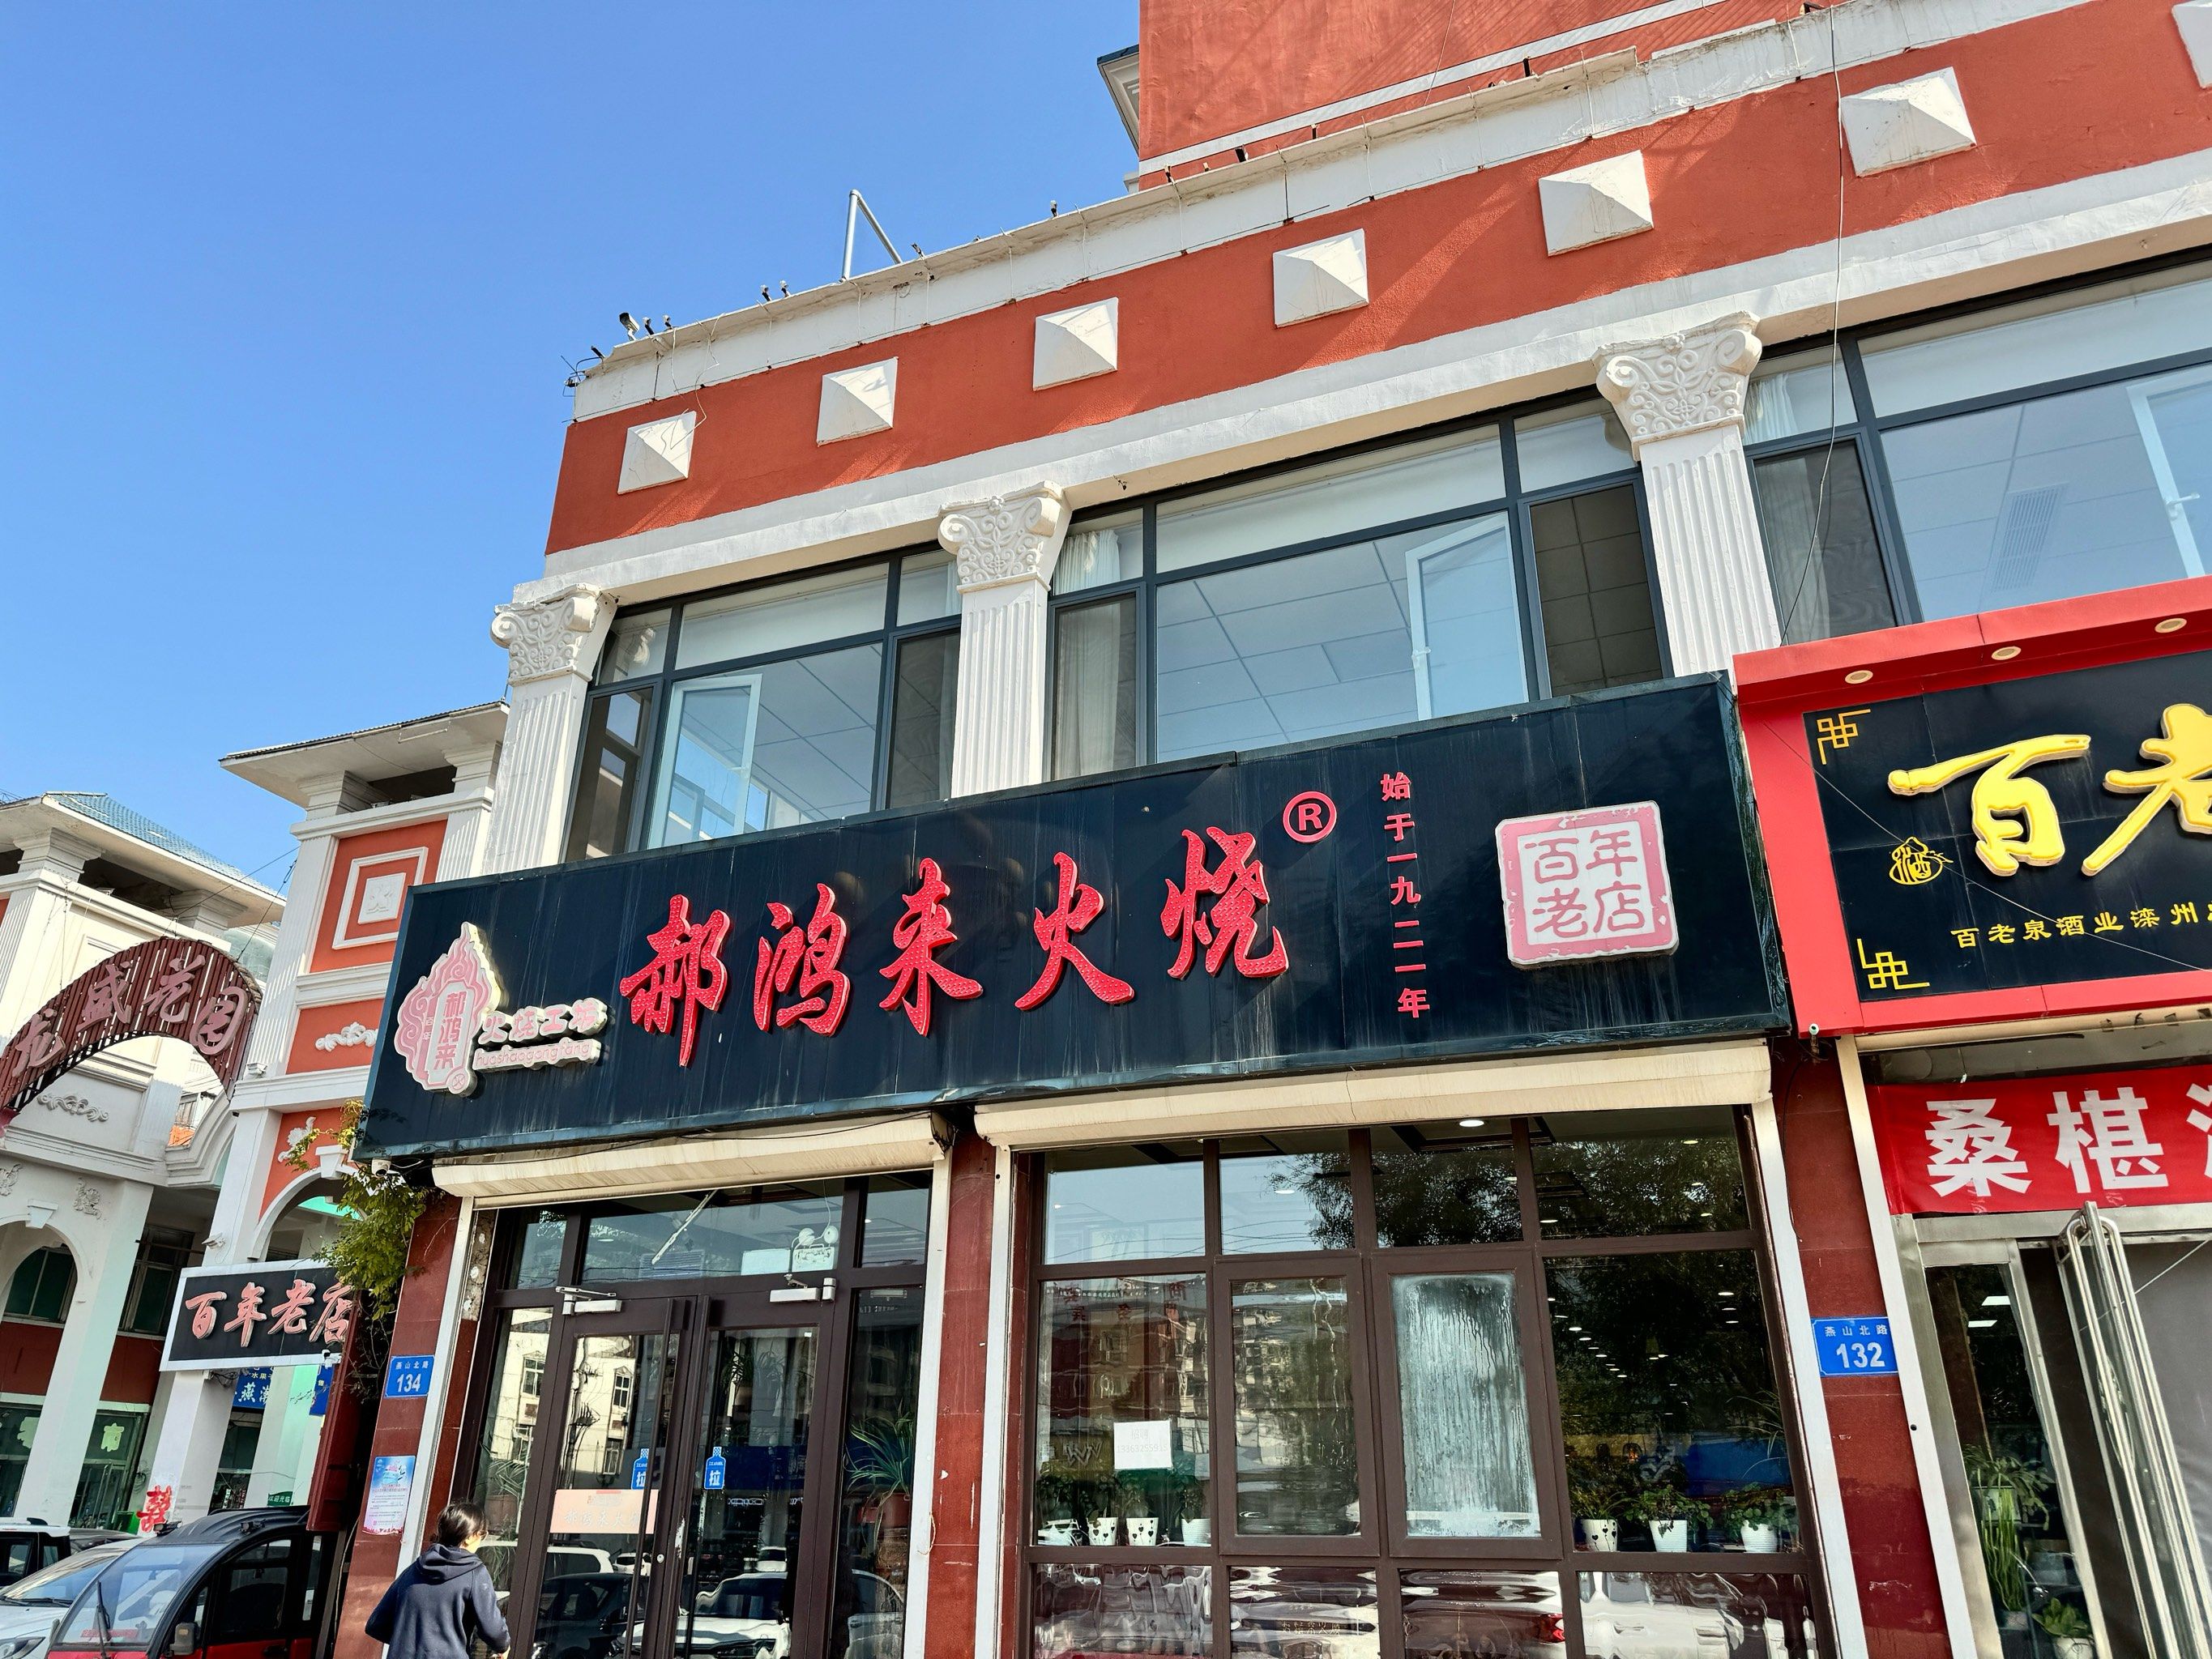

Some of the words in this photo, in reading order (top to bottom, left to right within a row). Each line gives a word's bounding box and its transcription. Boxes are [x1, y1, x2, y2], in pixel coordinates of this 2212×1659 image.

[1524, 829, 1638, 884] 百年
[1380, 771, 1430, 1018] 始于一九二一年
[1533, 881, 1645, 938] 老店
[620, 826, 1289, 1067] 郝鸿来火烧
[1950, 901, 2212, 949] 百老泉酒业滦州
[433, 991, 468, 1070] 郝鸿来
[478, 999, 599, 1043] 火烧工坊
[185, 1279, 353, 1348] 百年老店
[1824, 1324, 1888, 1337] 燕山北路
[1835, 1341, 1885, 1369] 132
[396, 1373, 421, 1392] 134
[709, 1470, 721, 1486] 拉
